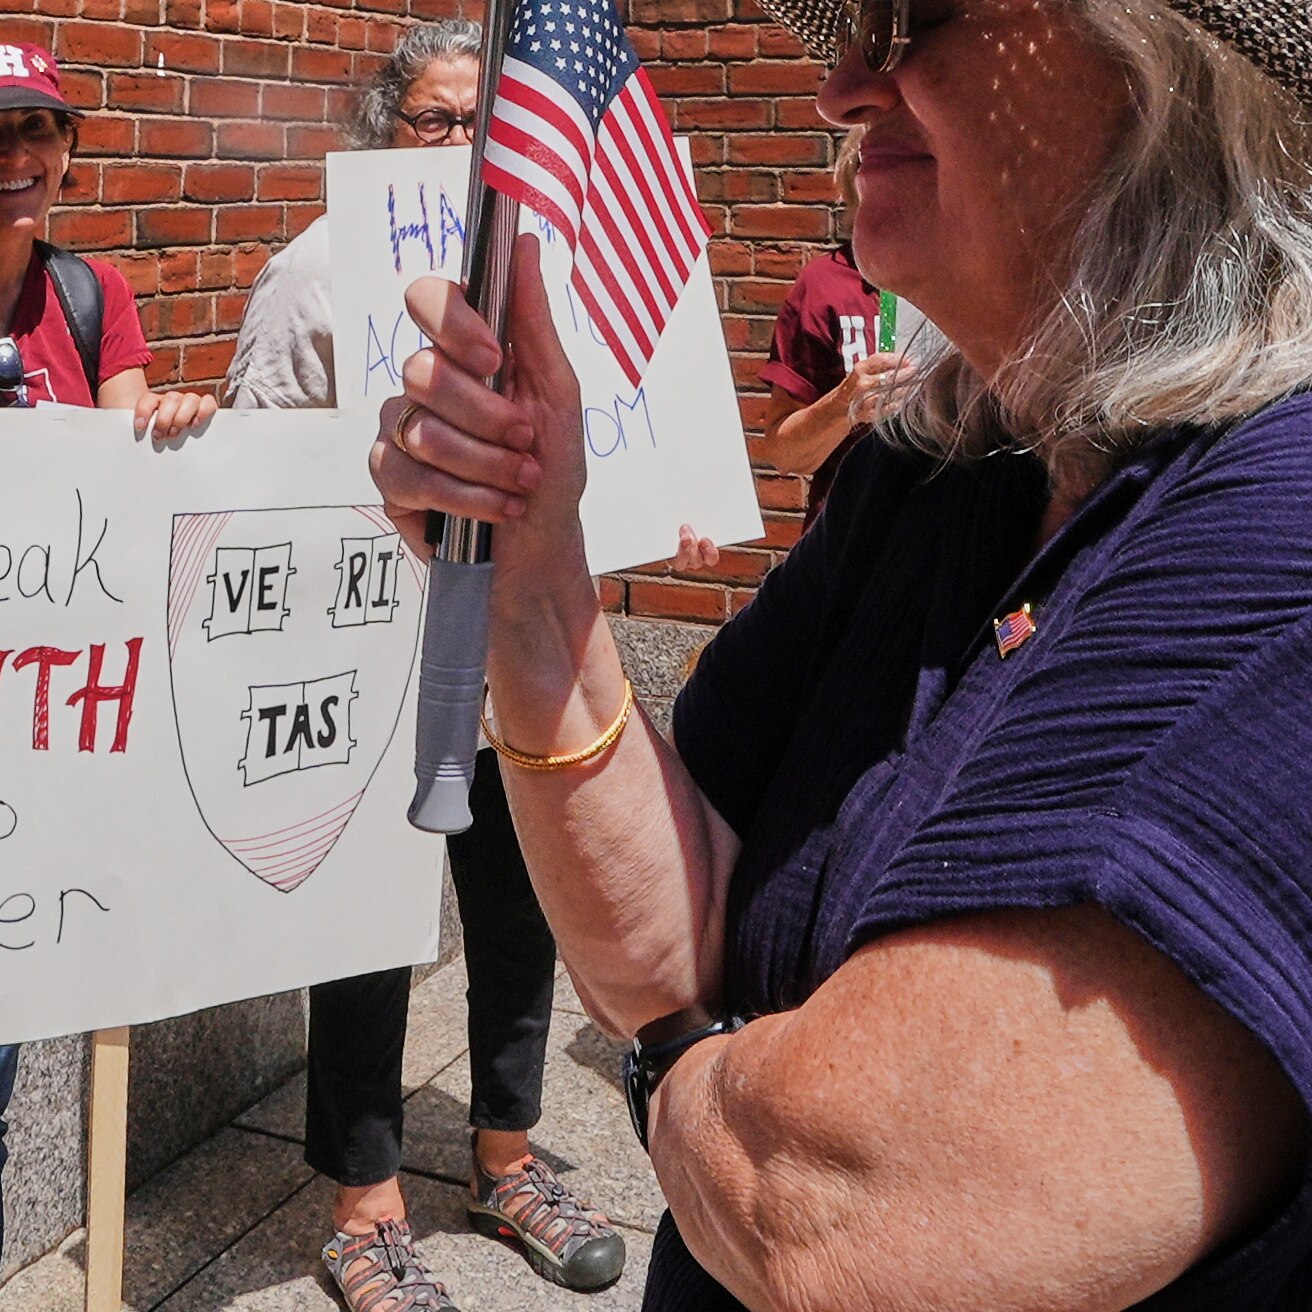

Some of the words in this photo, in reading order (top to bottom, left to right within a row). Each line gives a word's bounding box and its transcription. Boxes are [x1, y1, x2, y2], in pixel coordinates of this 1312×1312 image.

[223, 565, 282, 613] VE
[344, 549, 394, 608] RI
[257, 694, 340, 761] TAS
